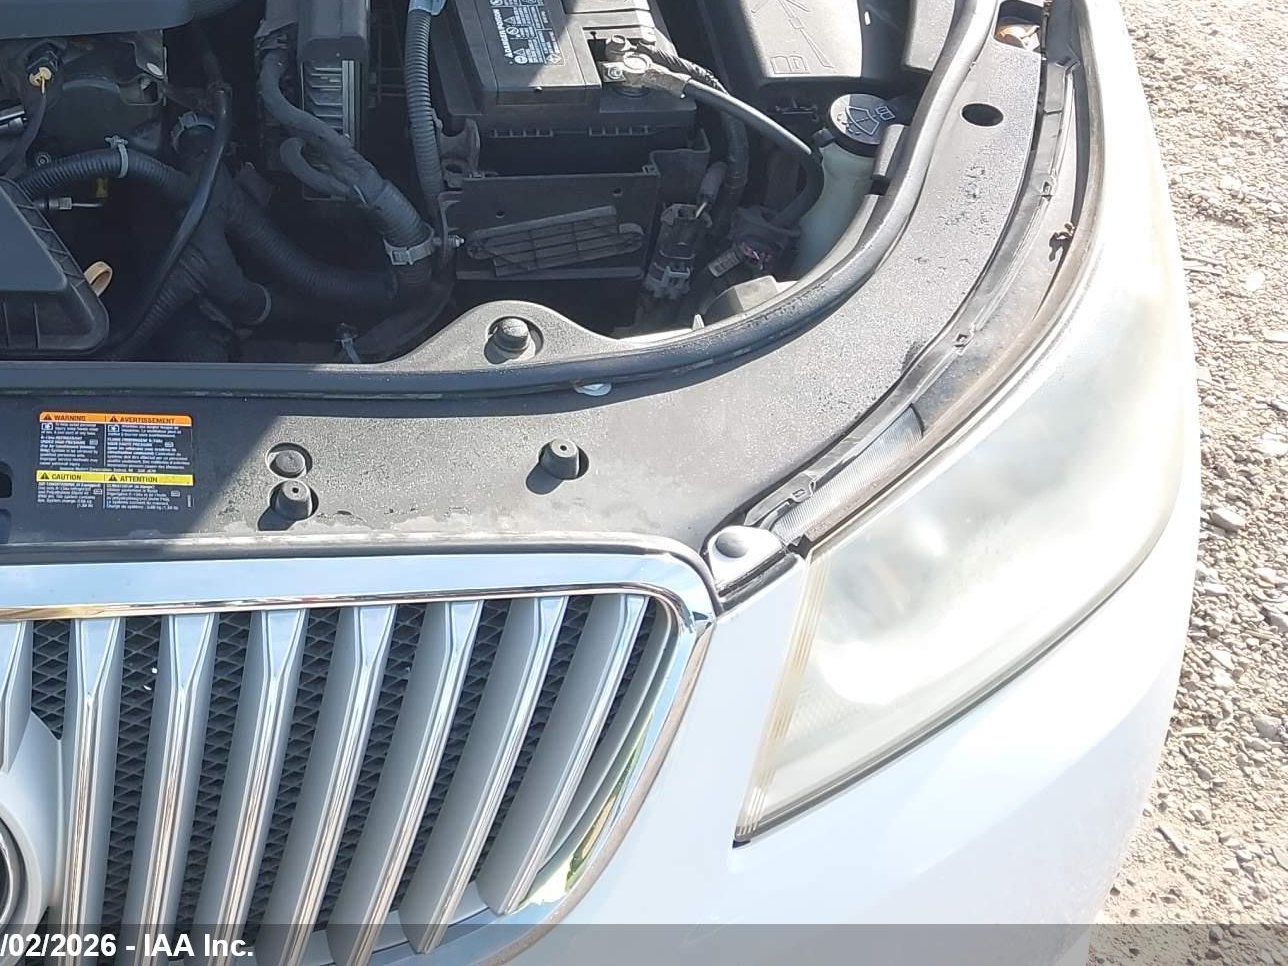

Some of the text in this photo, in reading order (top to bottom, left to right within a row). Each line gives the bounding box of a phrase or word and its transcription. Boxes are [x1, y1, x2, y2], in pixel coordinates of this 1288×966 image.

[120, 416, 176, 424] AVERTISSEMENT
[51, 473, 82, 481] CAUTION
[119, 475, 158, 483] ATTENTION
